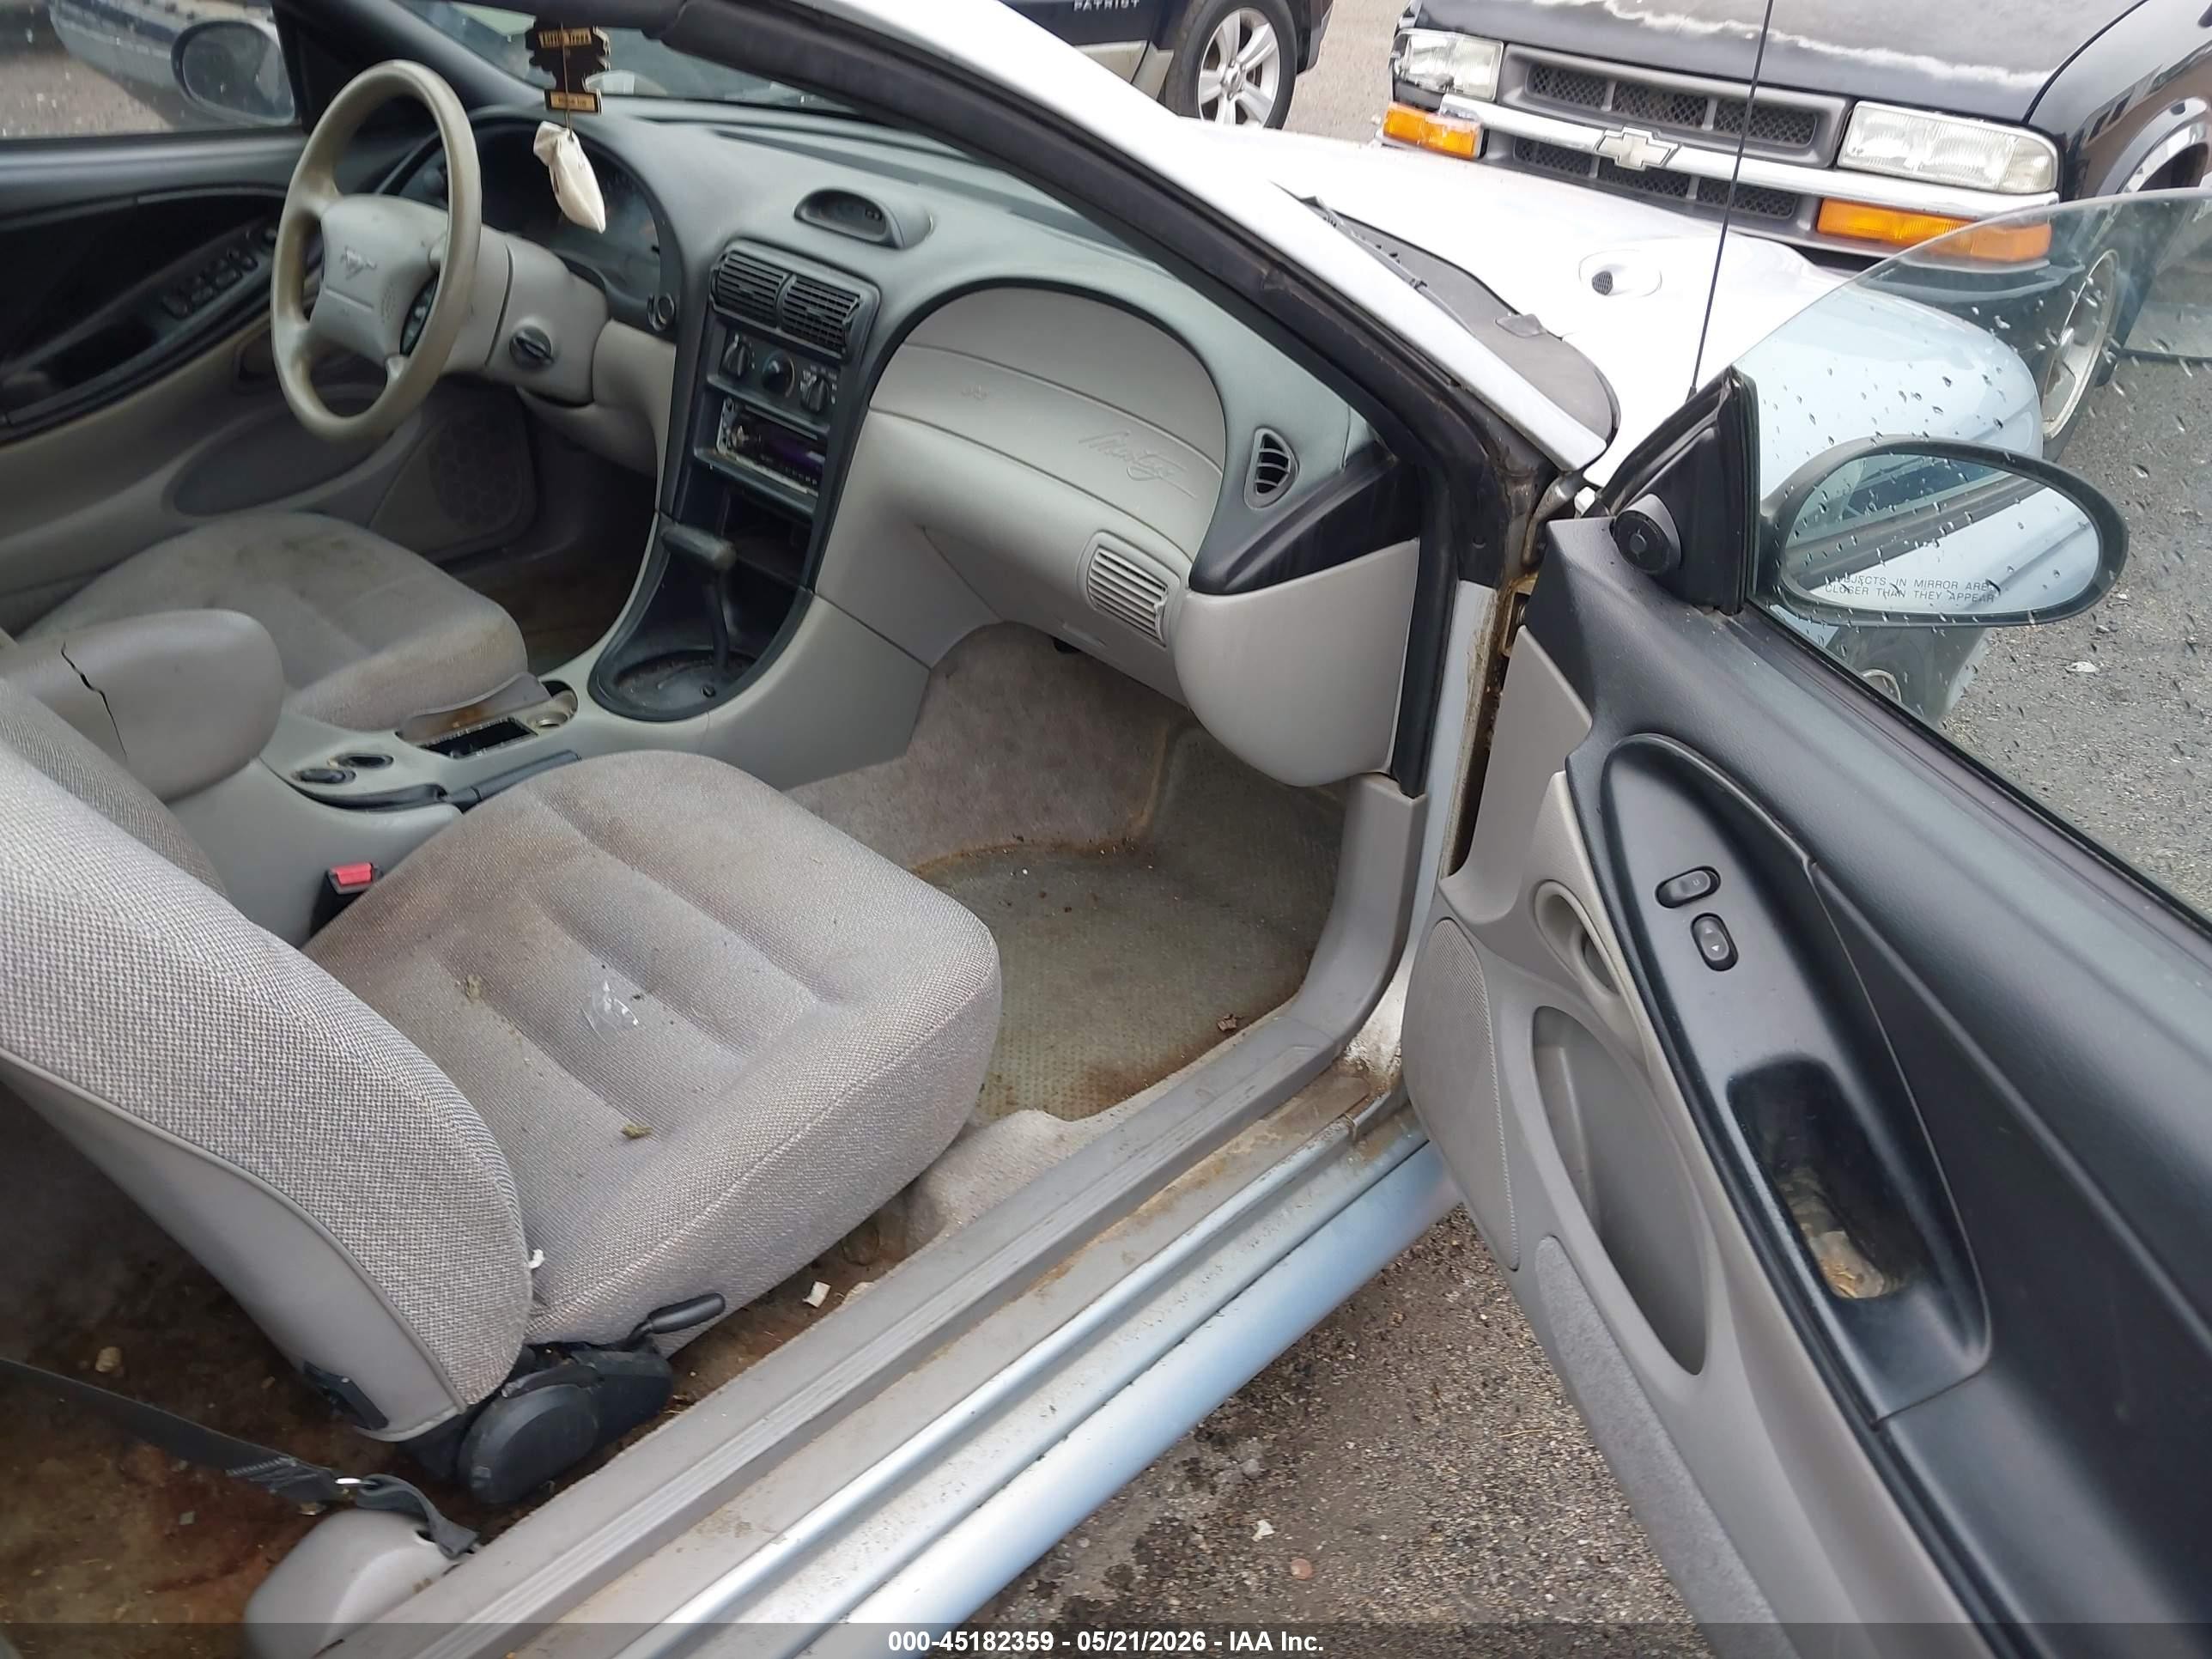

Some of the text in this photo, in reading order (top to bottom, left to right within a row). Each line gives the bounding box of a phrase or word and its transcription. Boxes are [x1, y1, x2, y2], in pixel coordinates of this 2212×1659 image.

[1073, 0, 1140, 11] PATRIOT
[1896, 578, 1907, 586] IN
[1913, 579, 1959, 590] MIRROR
[1965, 582, 1988, 592] ARE
[1876, 588, 1906, 599] THAN
[1913, 590, 1942, 600] THEY
[1948, 592, 1995, 603] APPEAR
